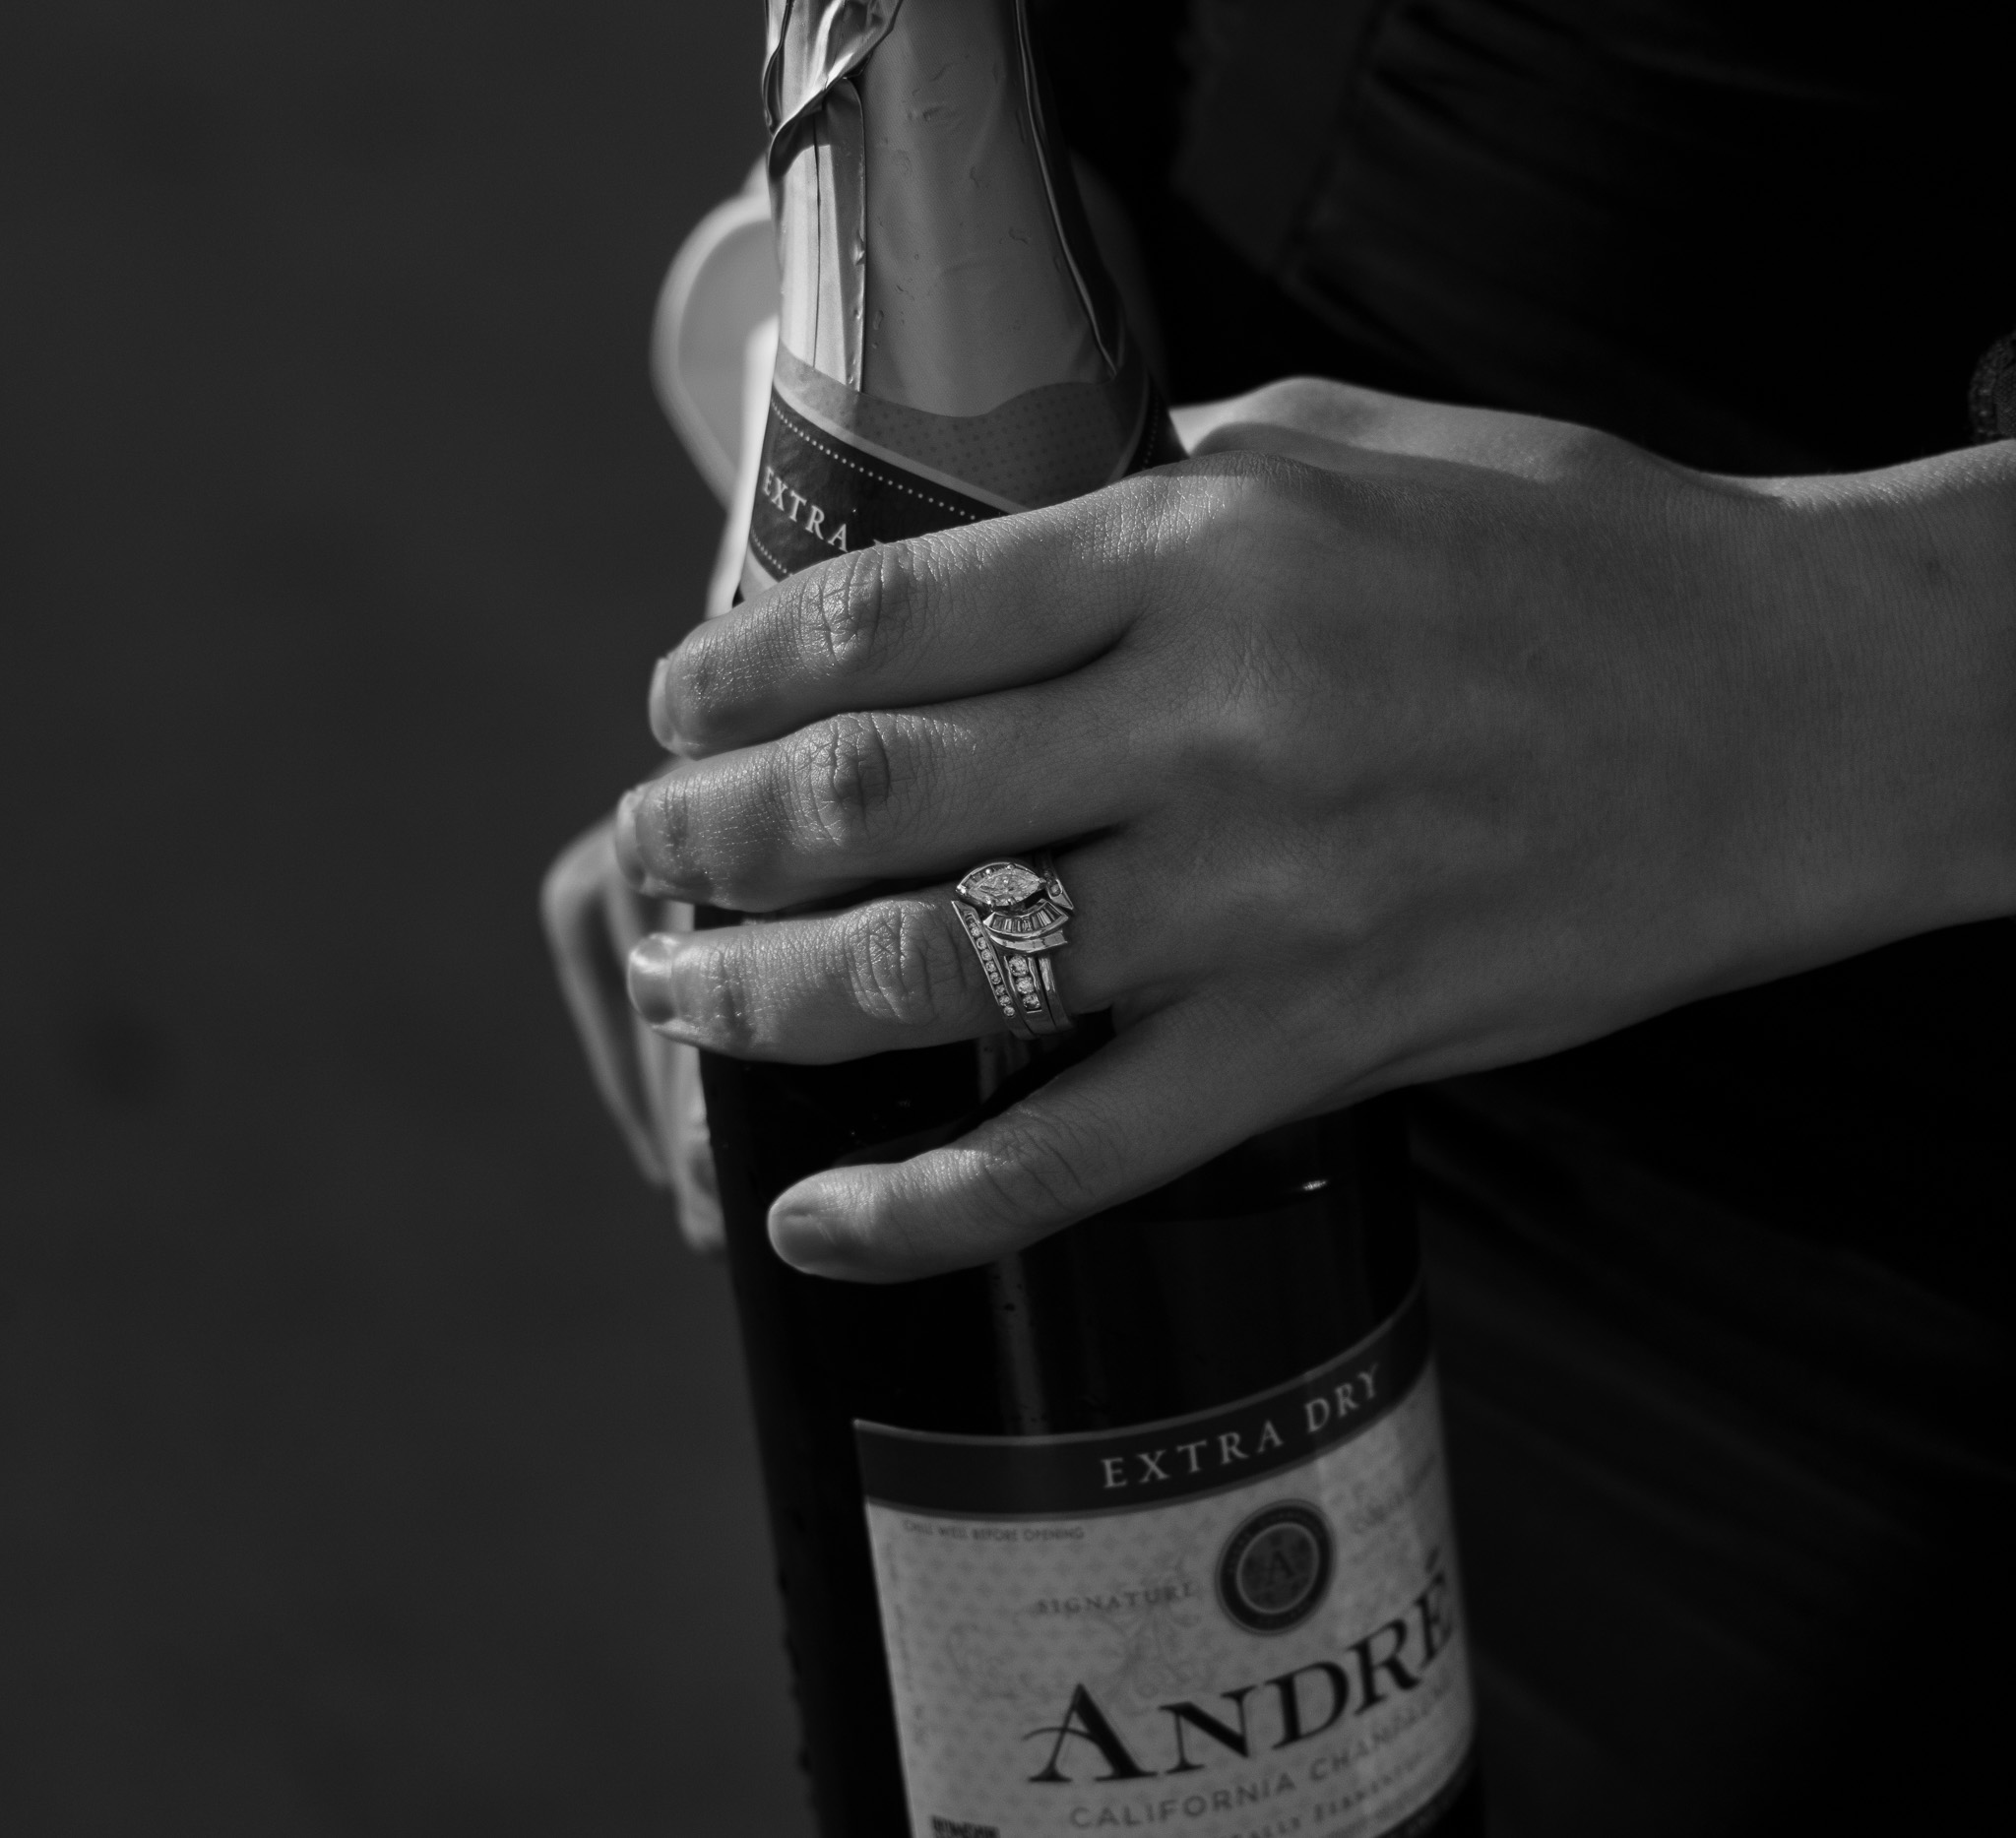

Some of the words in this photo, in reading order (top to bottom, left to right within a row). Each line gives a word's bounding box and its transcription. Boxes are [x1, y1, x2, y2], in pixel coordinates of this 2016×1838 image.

[763, 465, 849, 553] EXTRA
[1101, 1419, 1285, 1489] EXTRA
[1303, 1363, 1379, 1433] DRY
[1022, 1545, 1453, 1784] ANDRÉ
[1069, 1772, 1297, 1830] CALIFORNIA
